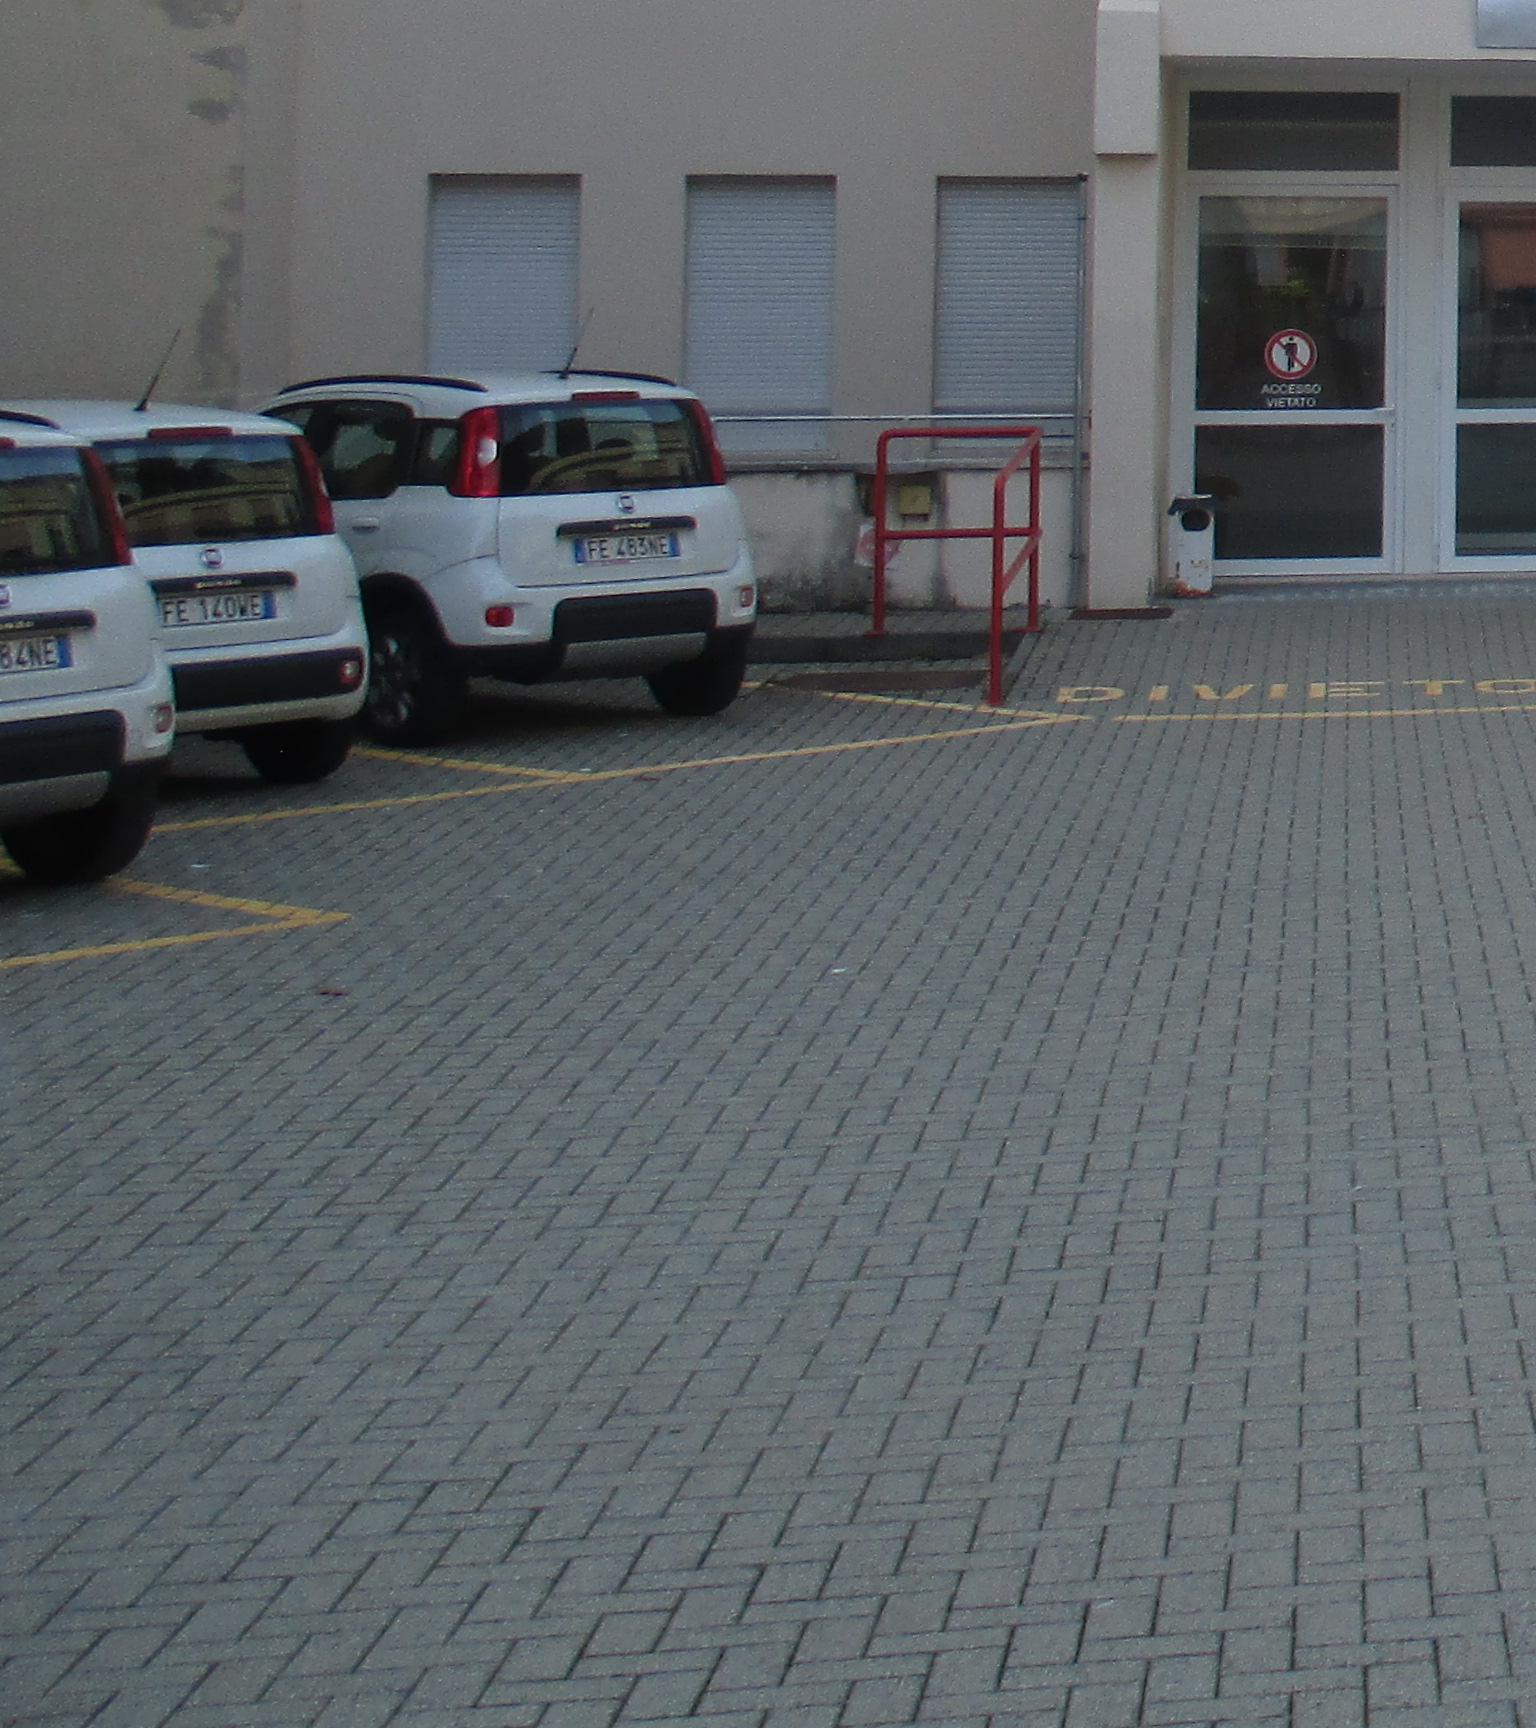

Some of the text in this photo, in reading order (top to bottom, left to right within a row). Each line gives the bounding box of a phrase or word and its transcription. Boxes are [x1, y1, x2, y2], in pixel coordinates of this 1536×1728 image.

[1261, 383, 1322, 394] ACCESSO
[1266, 397, 1317, 407] VIETATO
[587, 539, 611, 560] FE
[163, 599, 188, 623] FE
